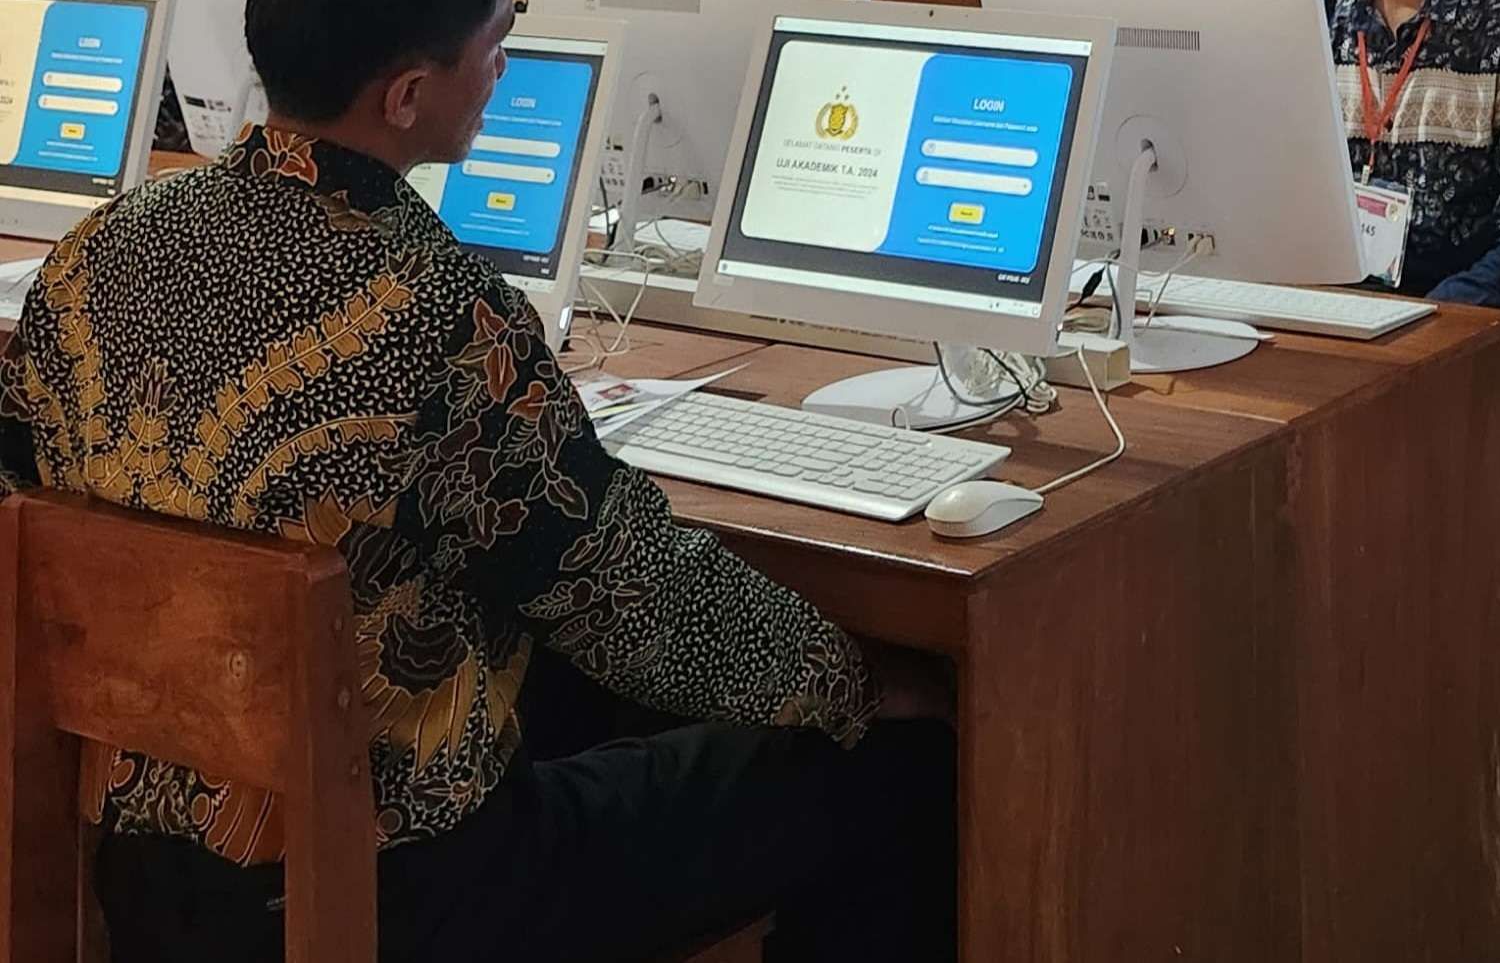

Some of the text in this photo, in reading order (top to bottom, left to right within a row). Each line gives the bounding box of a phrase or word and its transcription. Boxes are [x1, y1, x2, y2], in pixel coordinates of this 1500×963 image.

[973, 98, 1004, 111] LOGIN
[791, 159, 838, 173] AKADEMIK
[857, 167, 878, 178] 2024
